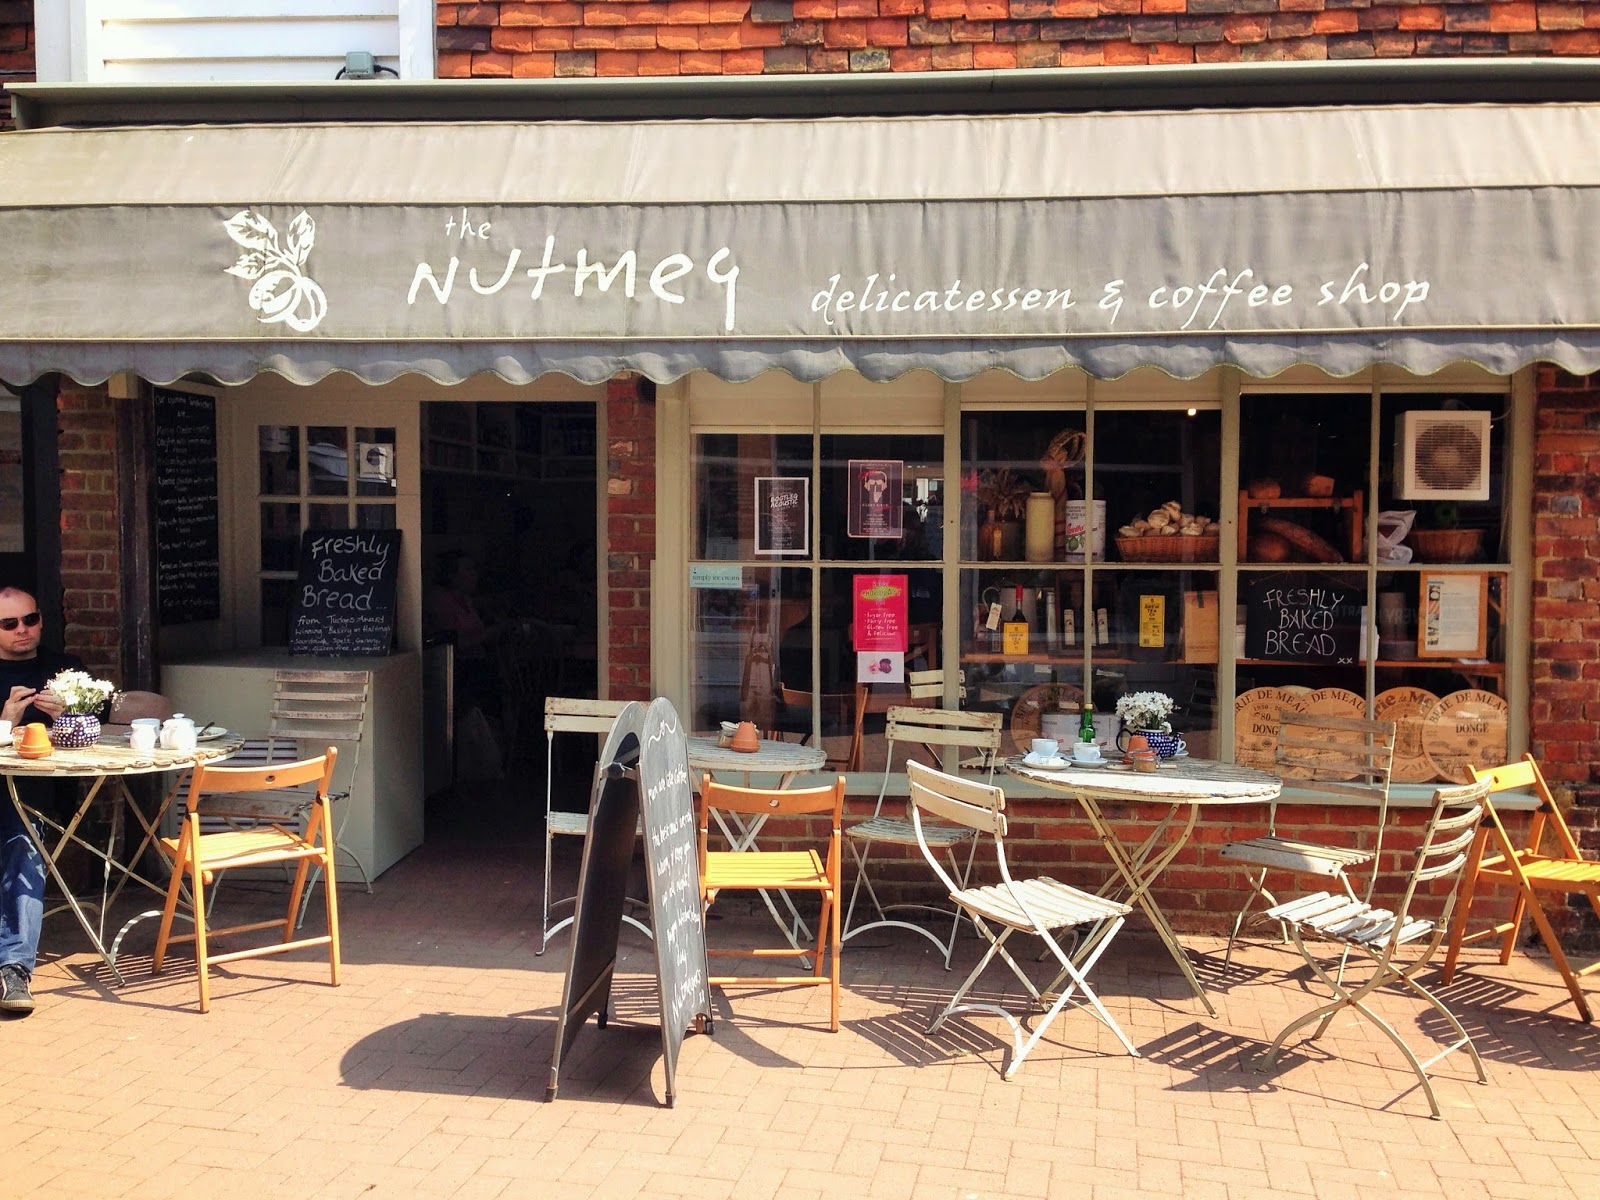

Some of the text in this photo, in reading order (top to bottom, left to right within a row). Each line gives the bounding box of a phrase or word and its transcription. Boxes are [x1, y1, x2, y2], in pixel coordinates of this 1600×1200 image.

[446, 208, 491, 239] the
[811, 263, 1429, 329] delicatessen & coffee shop
[770, 498, 798, 508] ACOUSTIC
[311, 534, 390, 565] Freshly
[318, 558, 387, 585] Baked
[1263, 588, 1345, 610] FRESHLY
[297, 615, 320, 627] from
[1279, 608, 1334, 631] BAKED
[1265, 629, 1336, 656] BREAD
[1235, 694, 1254, 714] RIE
[1257, 689, 1273, 699] DE
[1311, 690, 1327, 703] DE
[1260, 712, 1271, 721] 80
[1429, 699, 1453, 725] BRIE
[1455, 692, 1472, 704] DE
[1252, 723, 1280, 736] DONG
[1456, 722, 1489, 734] DONGE
